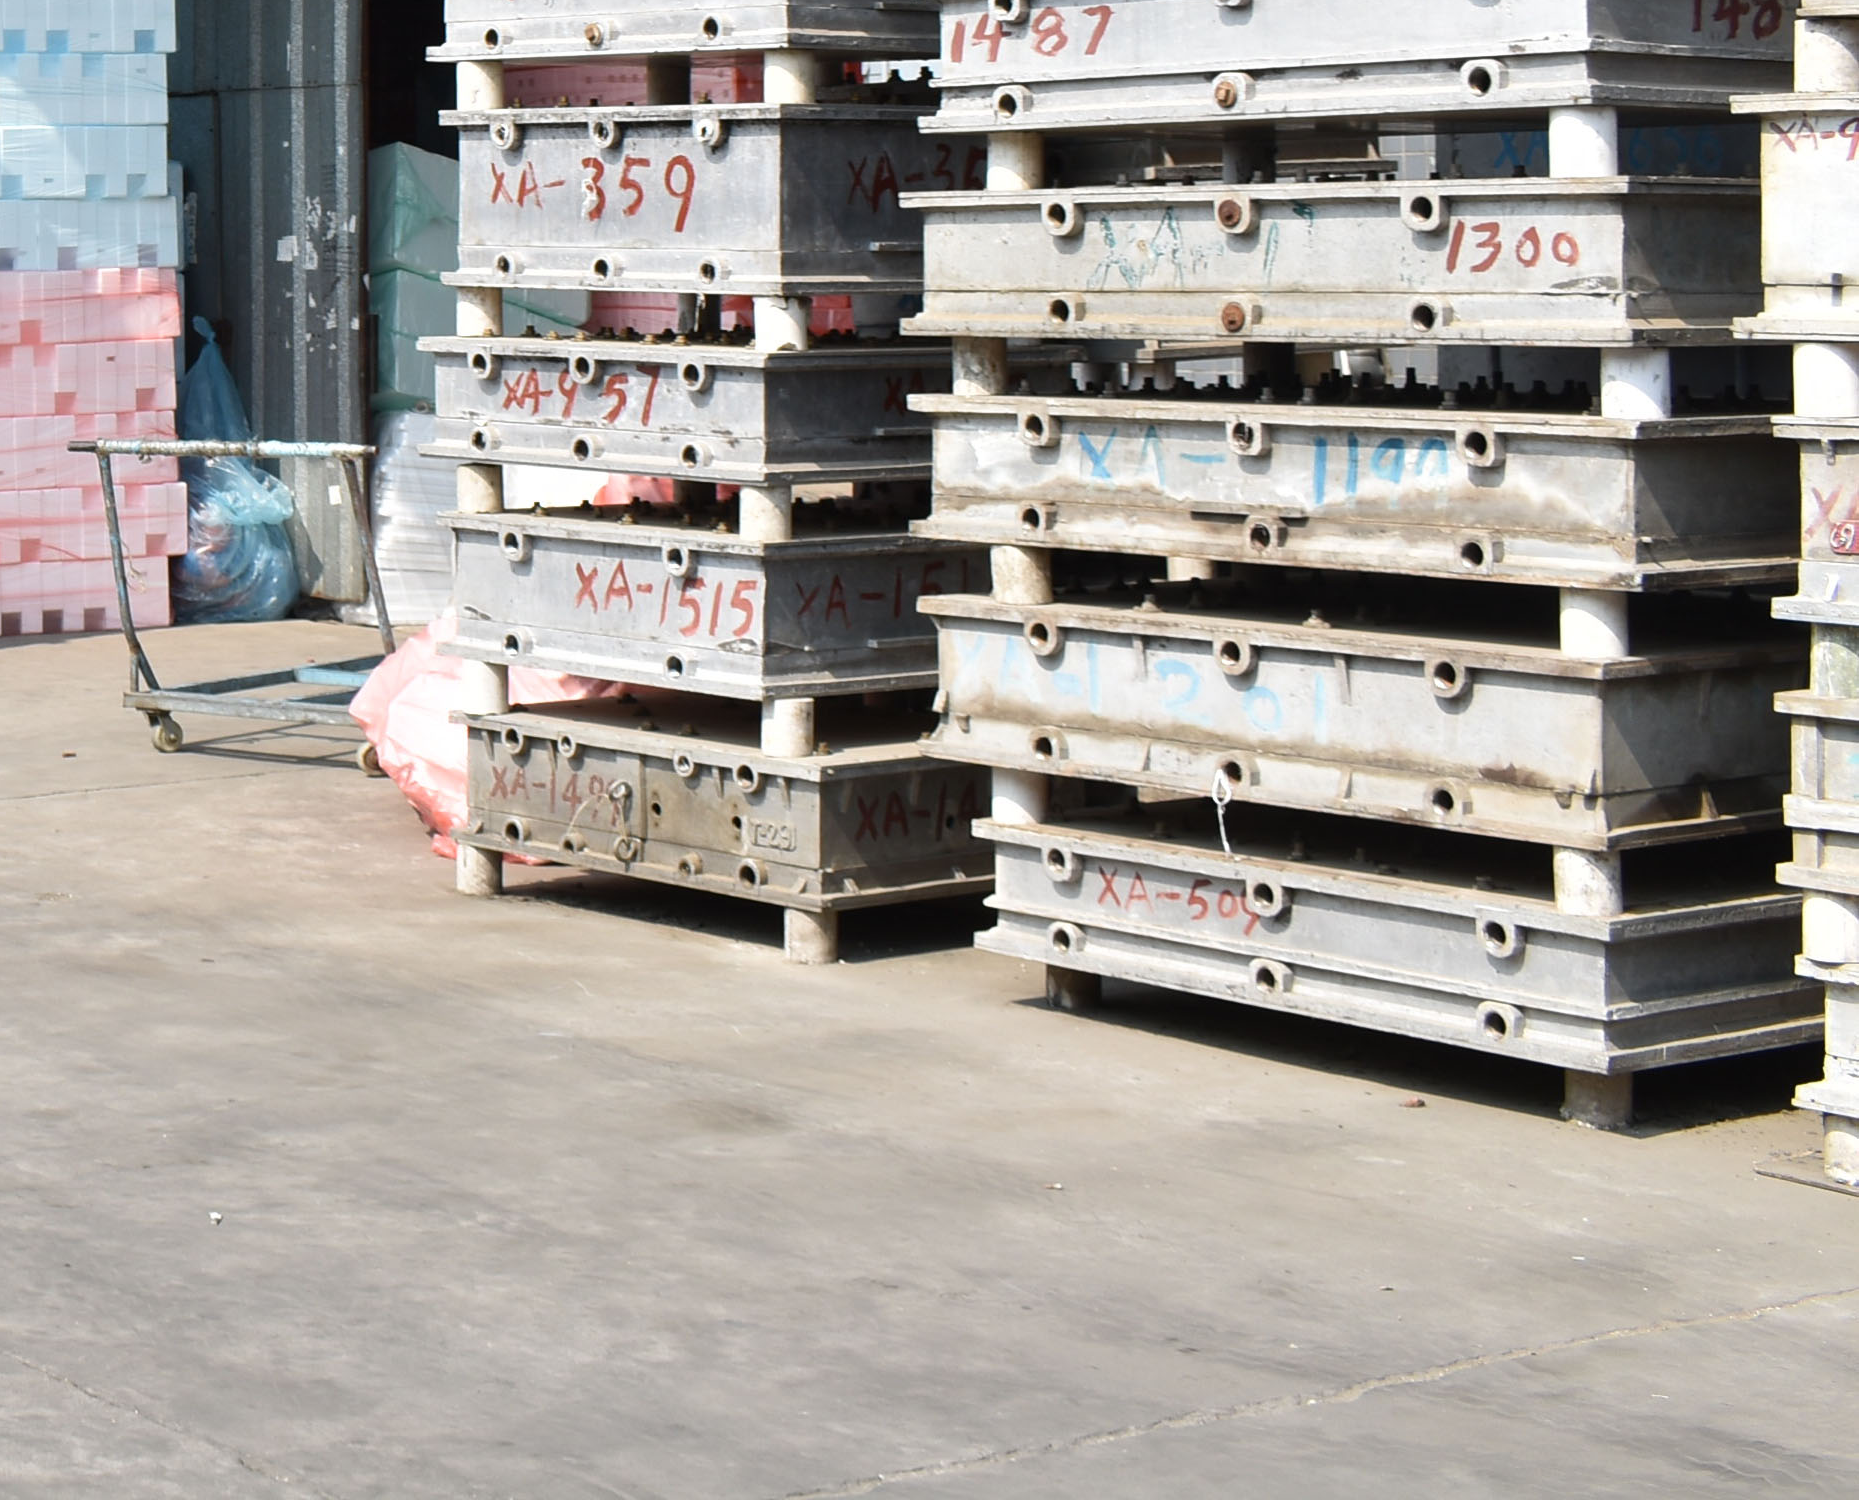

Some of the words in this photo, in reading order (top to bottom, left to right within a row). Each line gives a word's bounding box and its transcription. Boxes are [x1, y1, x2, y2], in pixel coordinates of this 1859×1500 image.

[950, 5, 1115, 63] 1487
[490, 154, 697, 234] XA-359
[1444, 219, 1582, 275] 1300
[574, 558, 759, 640] XA-1515
